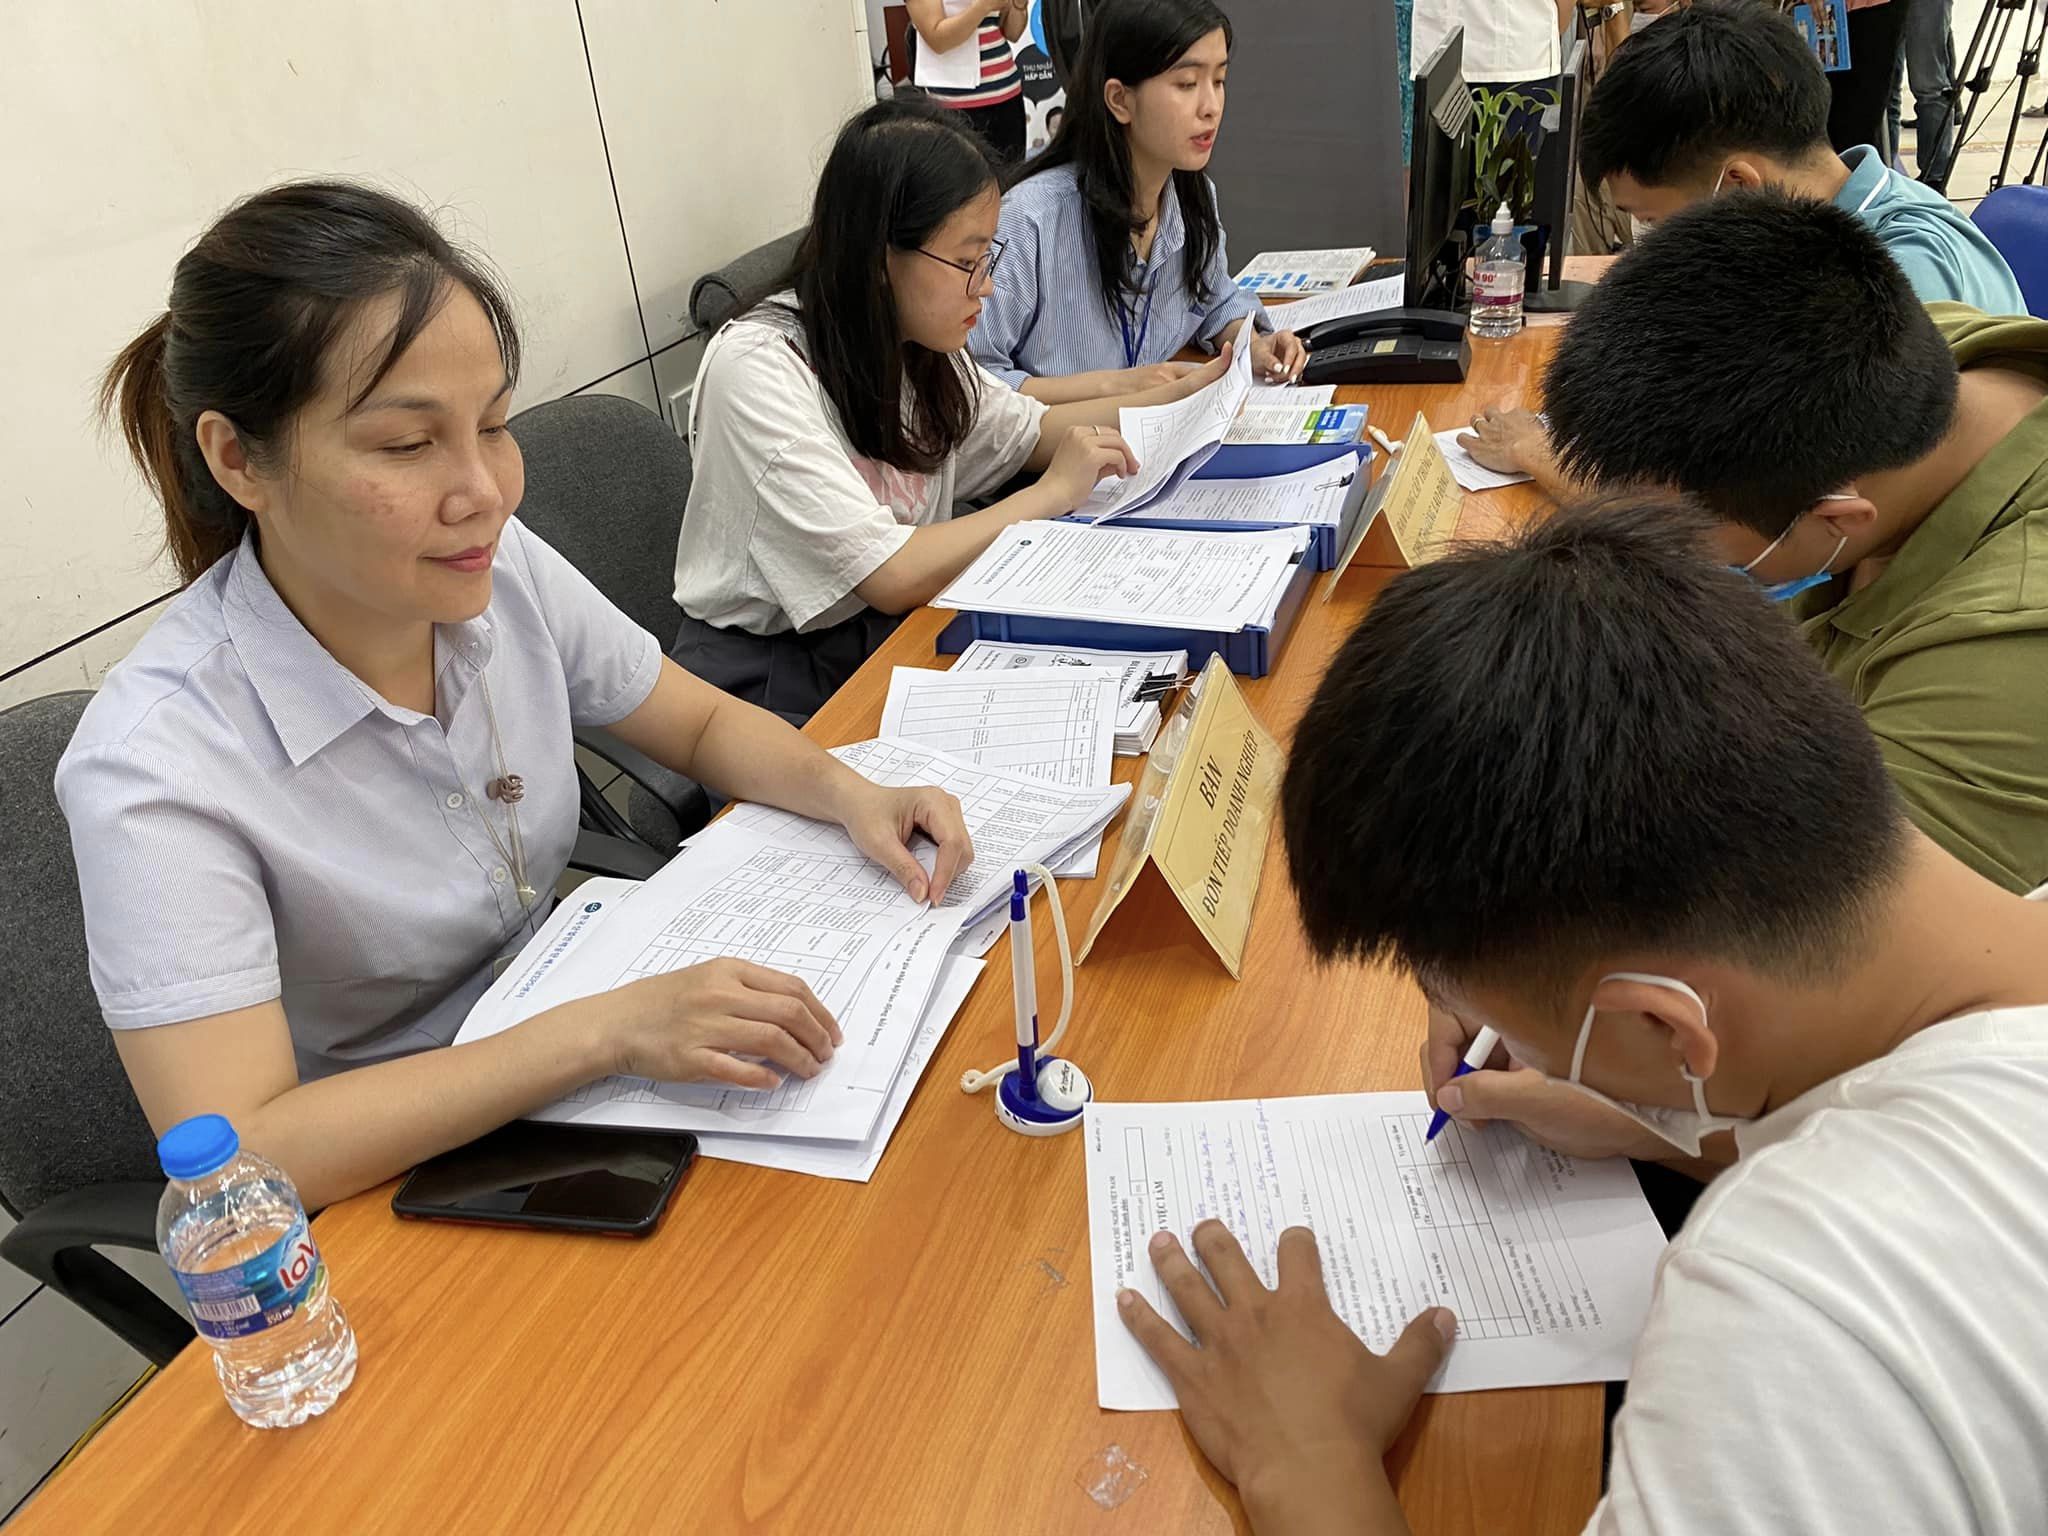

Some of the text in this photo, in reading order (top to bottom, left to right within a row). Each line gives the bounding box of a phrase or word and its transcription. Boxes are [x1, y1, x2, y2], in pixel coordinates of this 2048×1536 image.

[1200, 755, 1222, 810] BÀN
[1202, 730, 1259, 918] ĐÓN TIẾP DOANH NGHIỆP
[1153, 1180, 1164, 1200] LÀM
[1156, 1201, 1168, 1225] VIỆC
